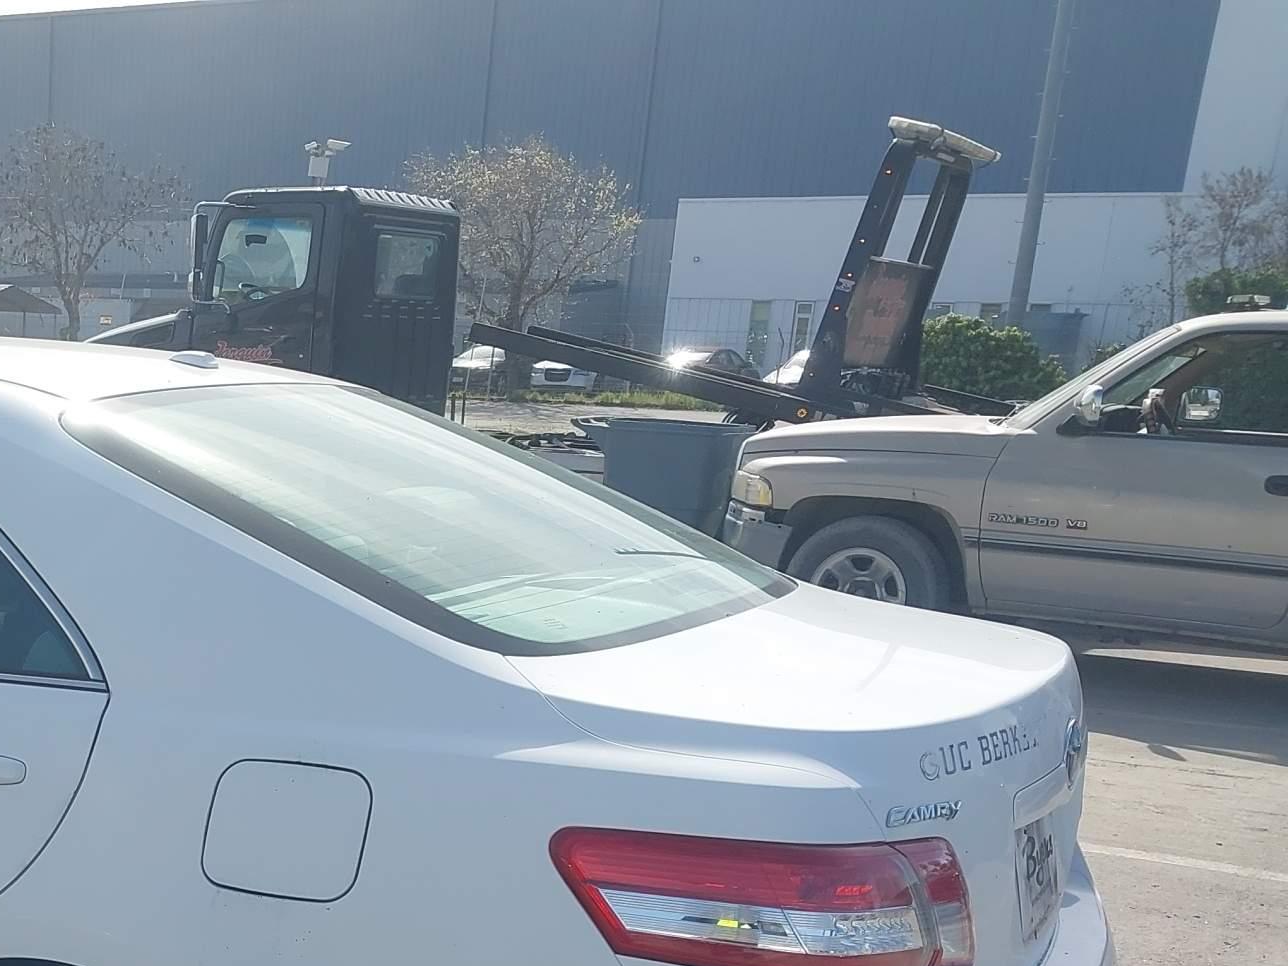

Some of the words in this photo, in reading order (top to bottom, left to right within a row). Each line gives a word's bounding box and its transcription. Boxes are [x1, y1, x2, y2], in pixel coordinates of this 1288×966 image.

[988, 512, 1017, 524] RAM
[1023, 515, 1059, 528] 1500
[1066, 518, 1088, 530] V8
[885, 799, 962, 828] CAMRY
